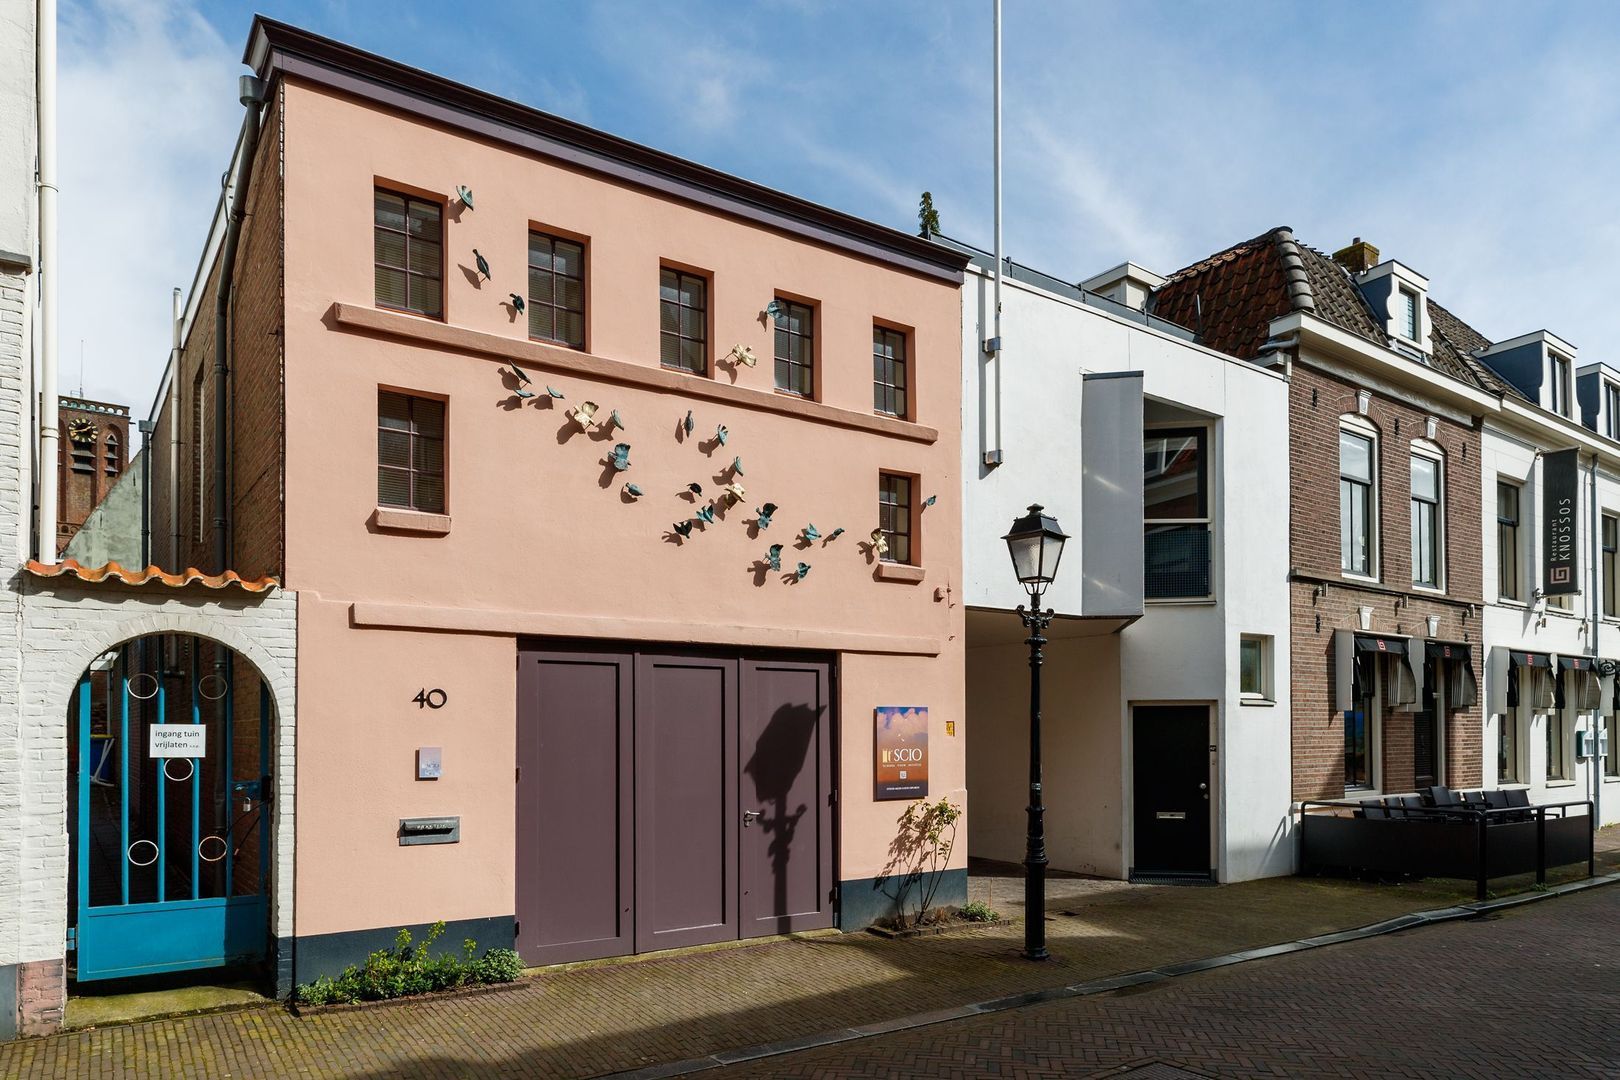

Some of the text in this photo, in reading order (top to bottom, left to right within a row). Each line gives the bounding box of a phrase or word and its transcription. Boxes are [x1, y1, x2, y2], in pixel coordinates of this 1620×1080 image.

[1559, 498, 1571, 561] KNOSSOS
[411, 687, 448, 709] 40
[155, 730, 182, 738] ingang
[154, 741, 188, 749] vrijlaten
[893, 748, 922, 762] SCIO
